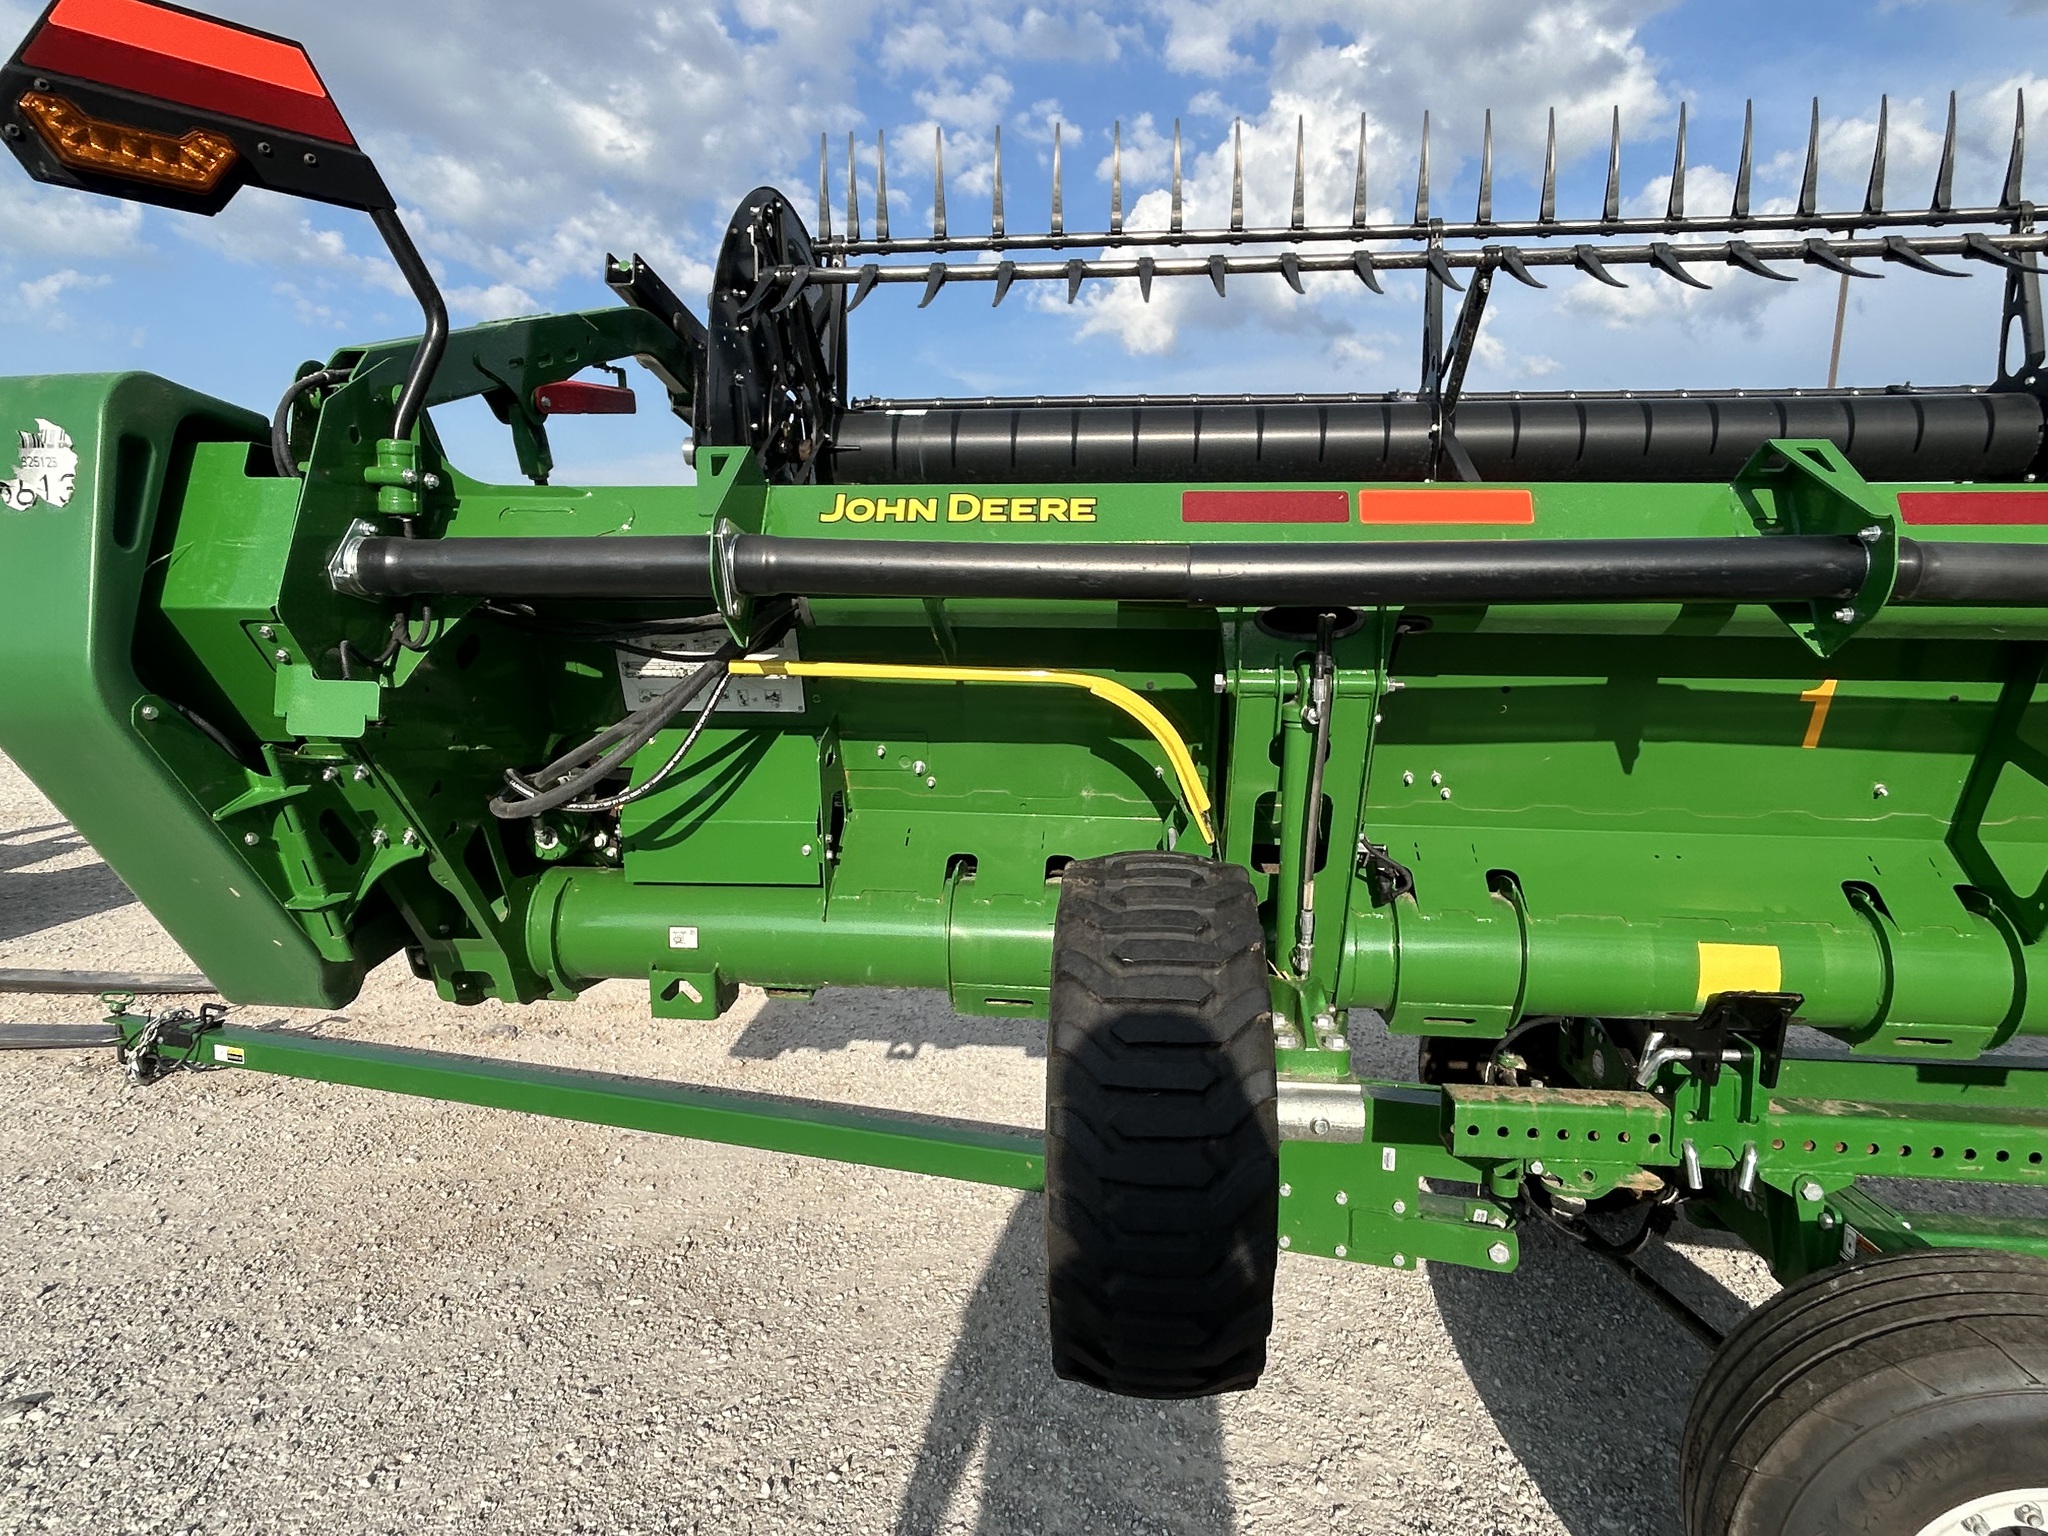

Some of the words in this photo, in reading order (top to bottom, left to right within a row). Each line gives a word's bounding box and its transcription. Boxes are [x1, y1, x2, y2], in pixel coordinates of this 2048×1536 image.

[819, 493, 938, 523] JOHN
[947, 493, 1097, 523] DEERE
[1800, 679, 1837, 748] 1
